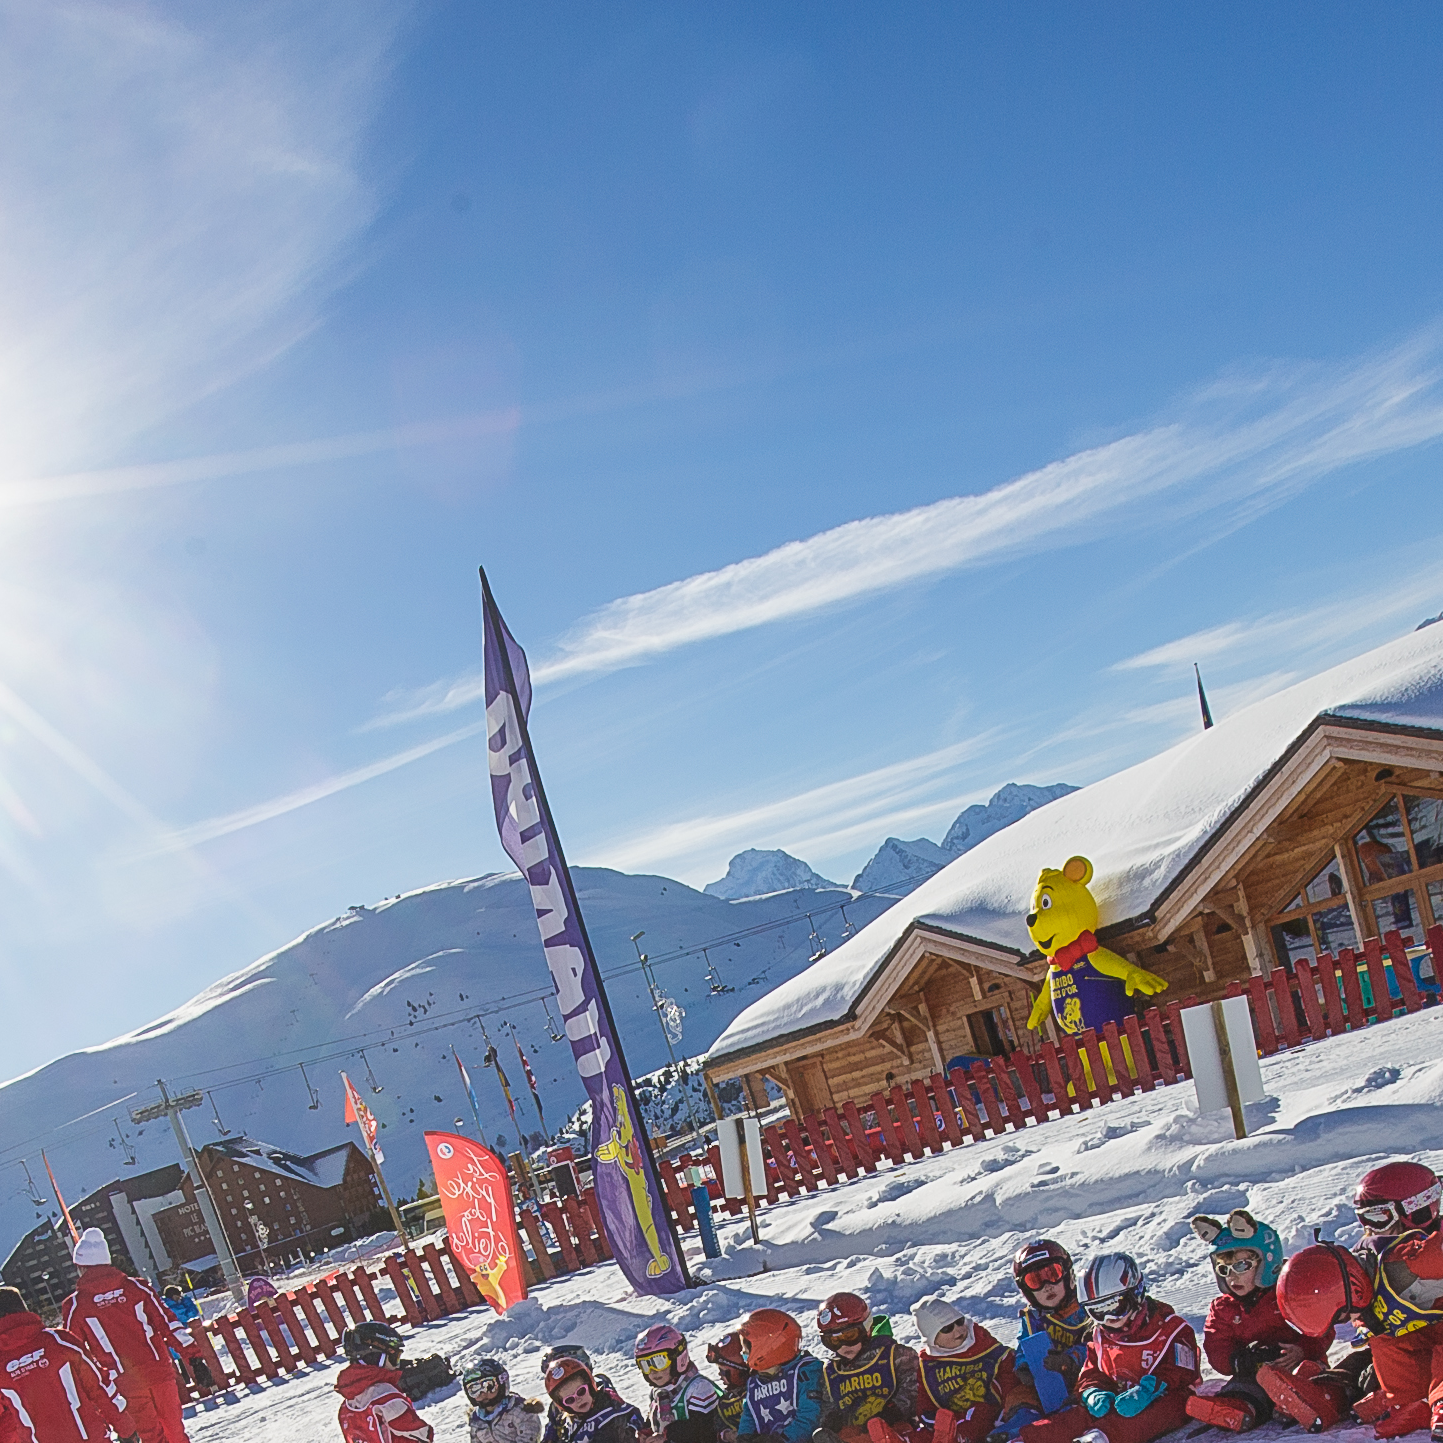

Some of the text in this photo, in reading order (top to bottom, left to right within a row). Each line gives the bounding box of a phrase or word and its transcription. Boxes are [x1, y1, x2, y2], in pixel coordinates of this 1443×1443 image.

[178, 1202, 199, 1216] HOTE
[183, 1226, 194, 1238] PIC
[839, 1372, 882, 1396] HARIBO
